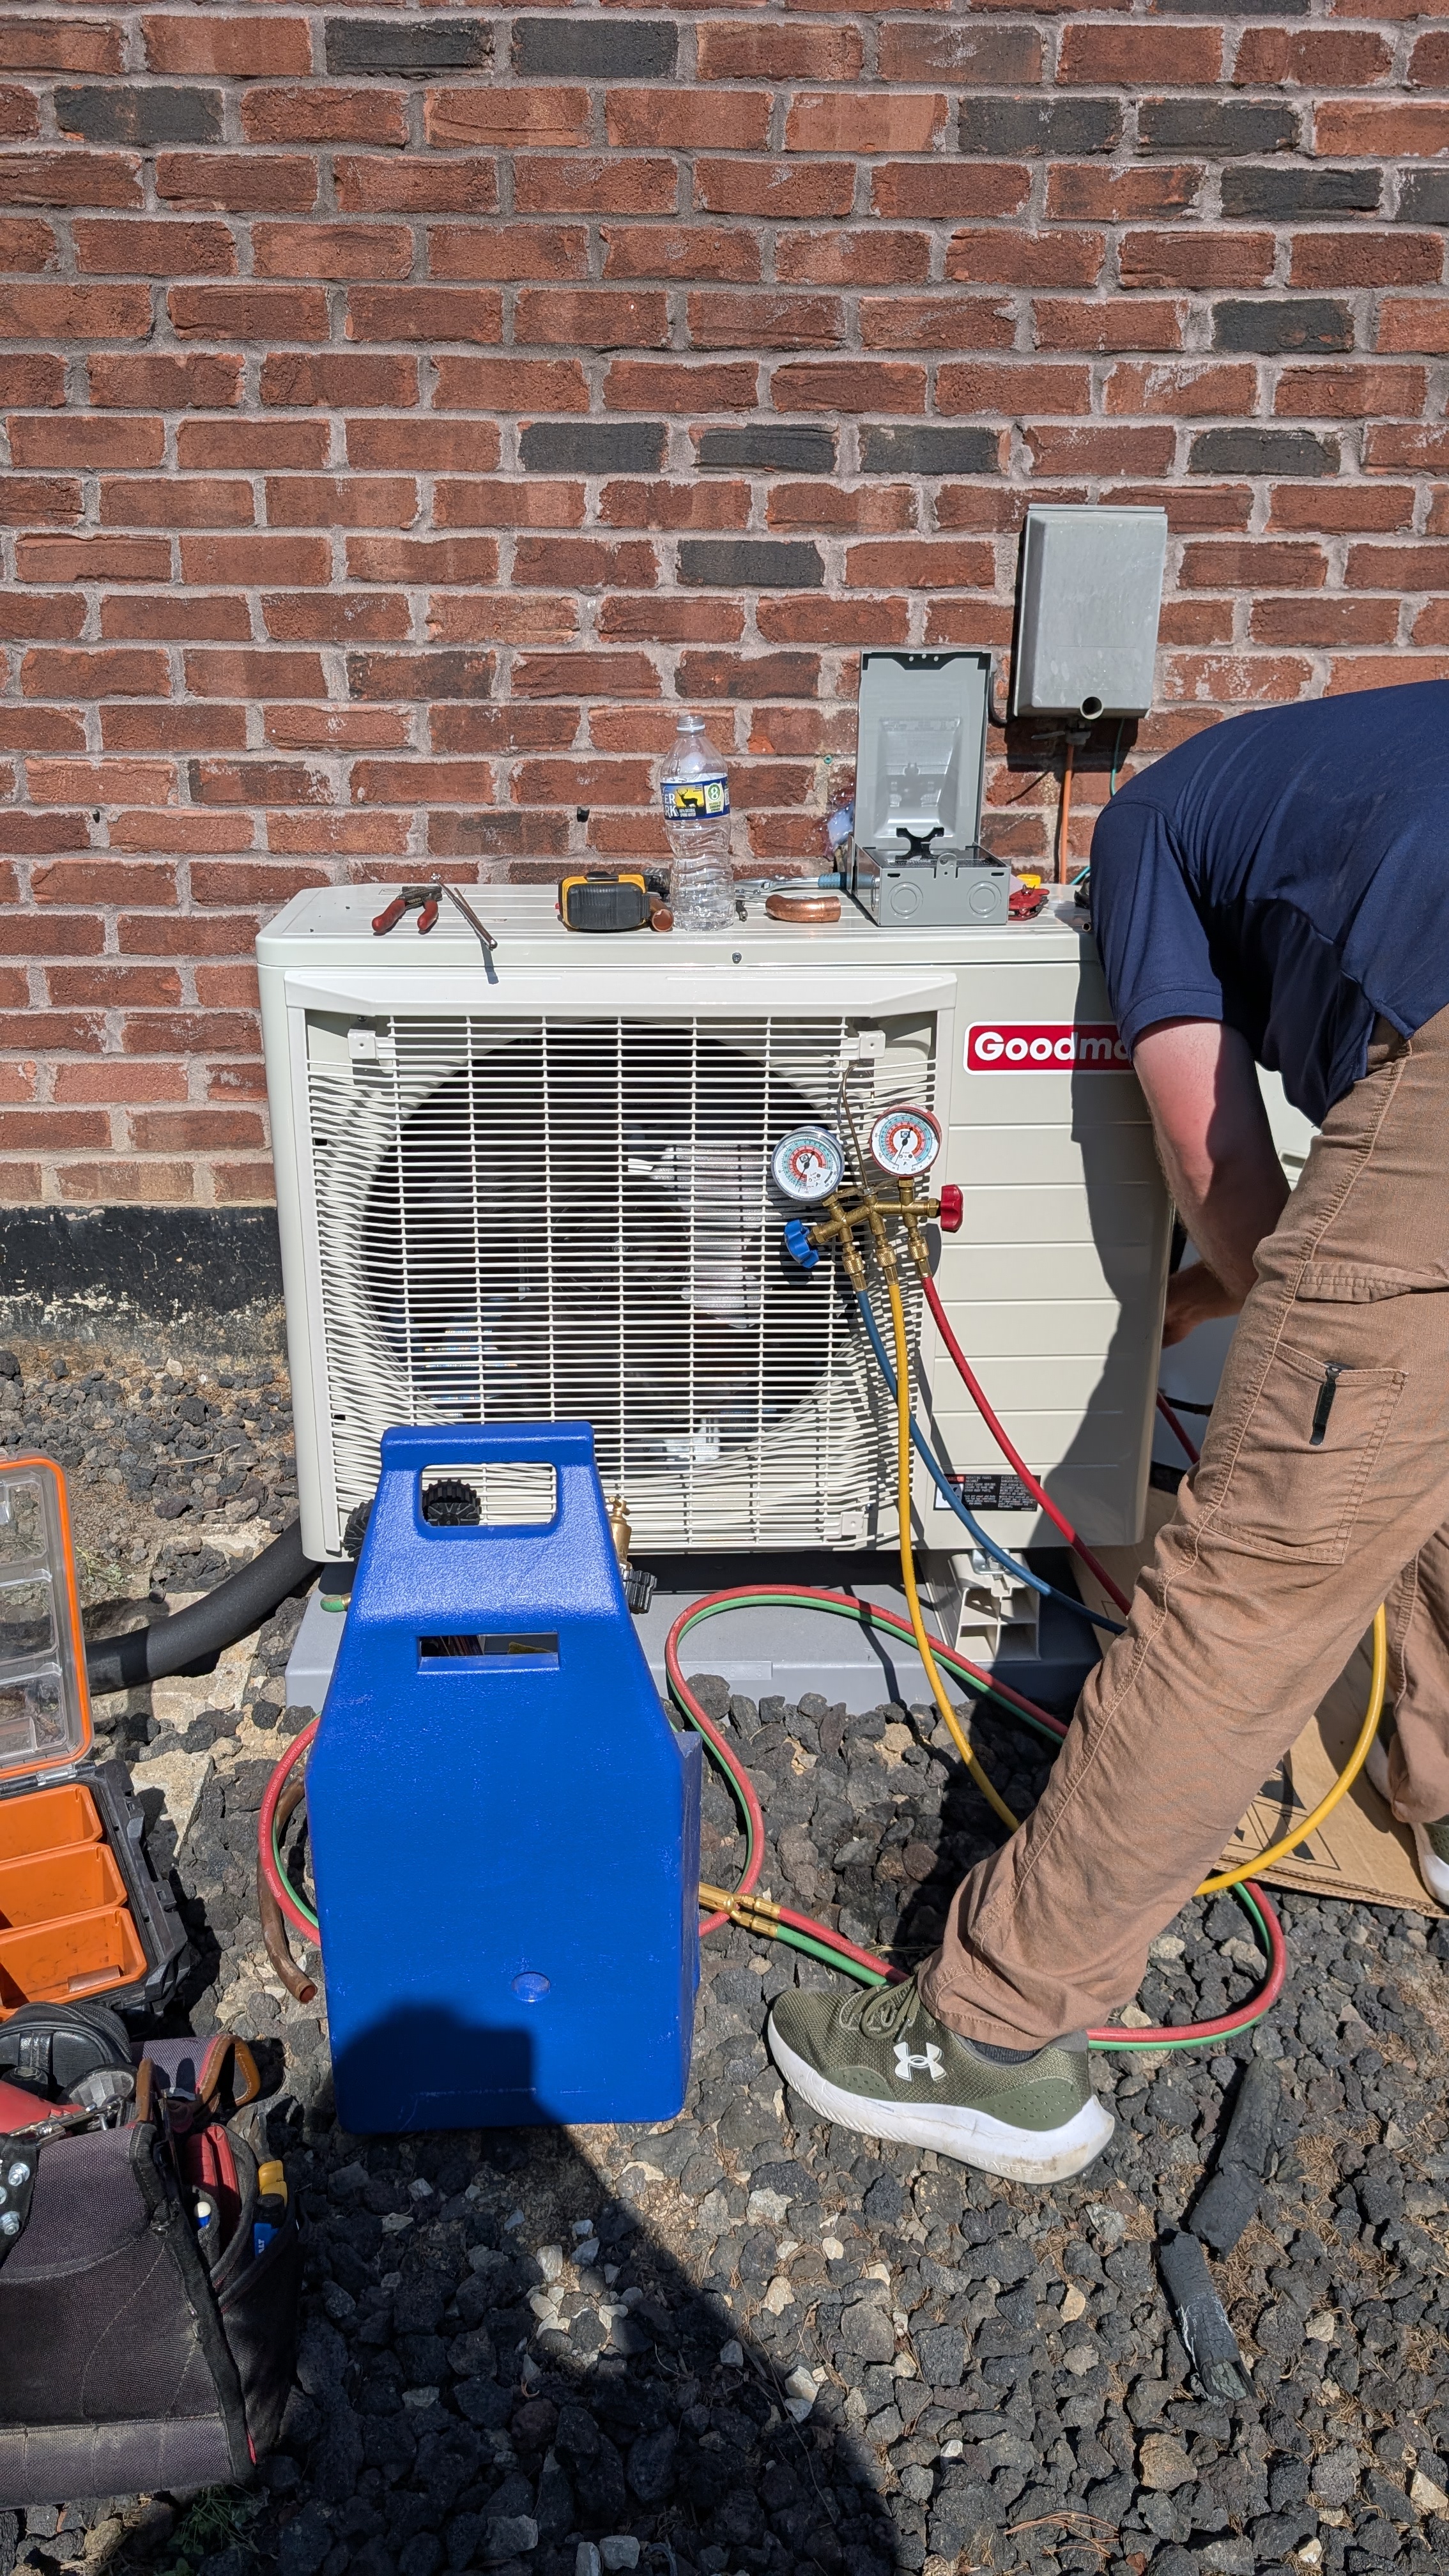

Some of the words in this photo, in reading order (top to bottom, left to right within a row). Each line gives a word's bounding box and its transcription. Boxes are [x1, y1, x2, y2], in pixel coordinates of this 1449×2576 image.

[266, 1779, 279, 1802] ACETYLENE
[277, 1767, 285, 1779] ONLY
[288, 1748, 298, 1759] DUTY
[296, 1739, 305, 1749] MAX
